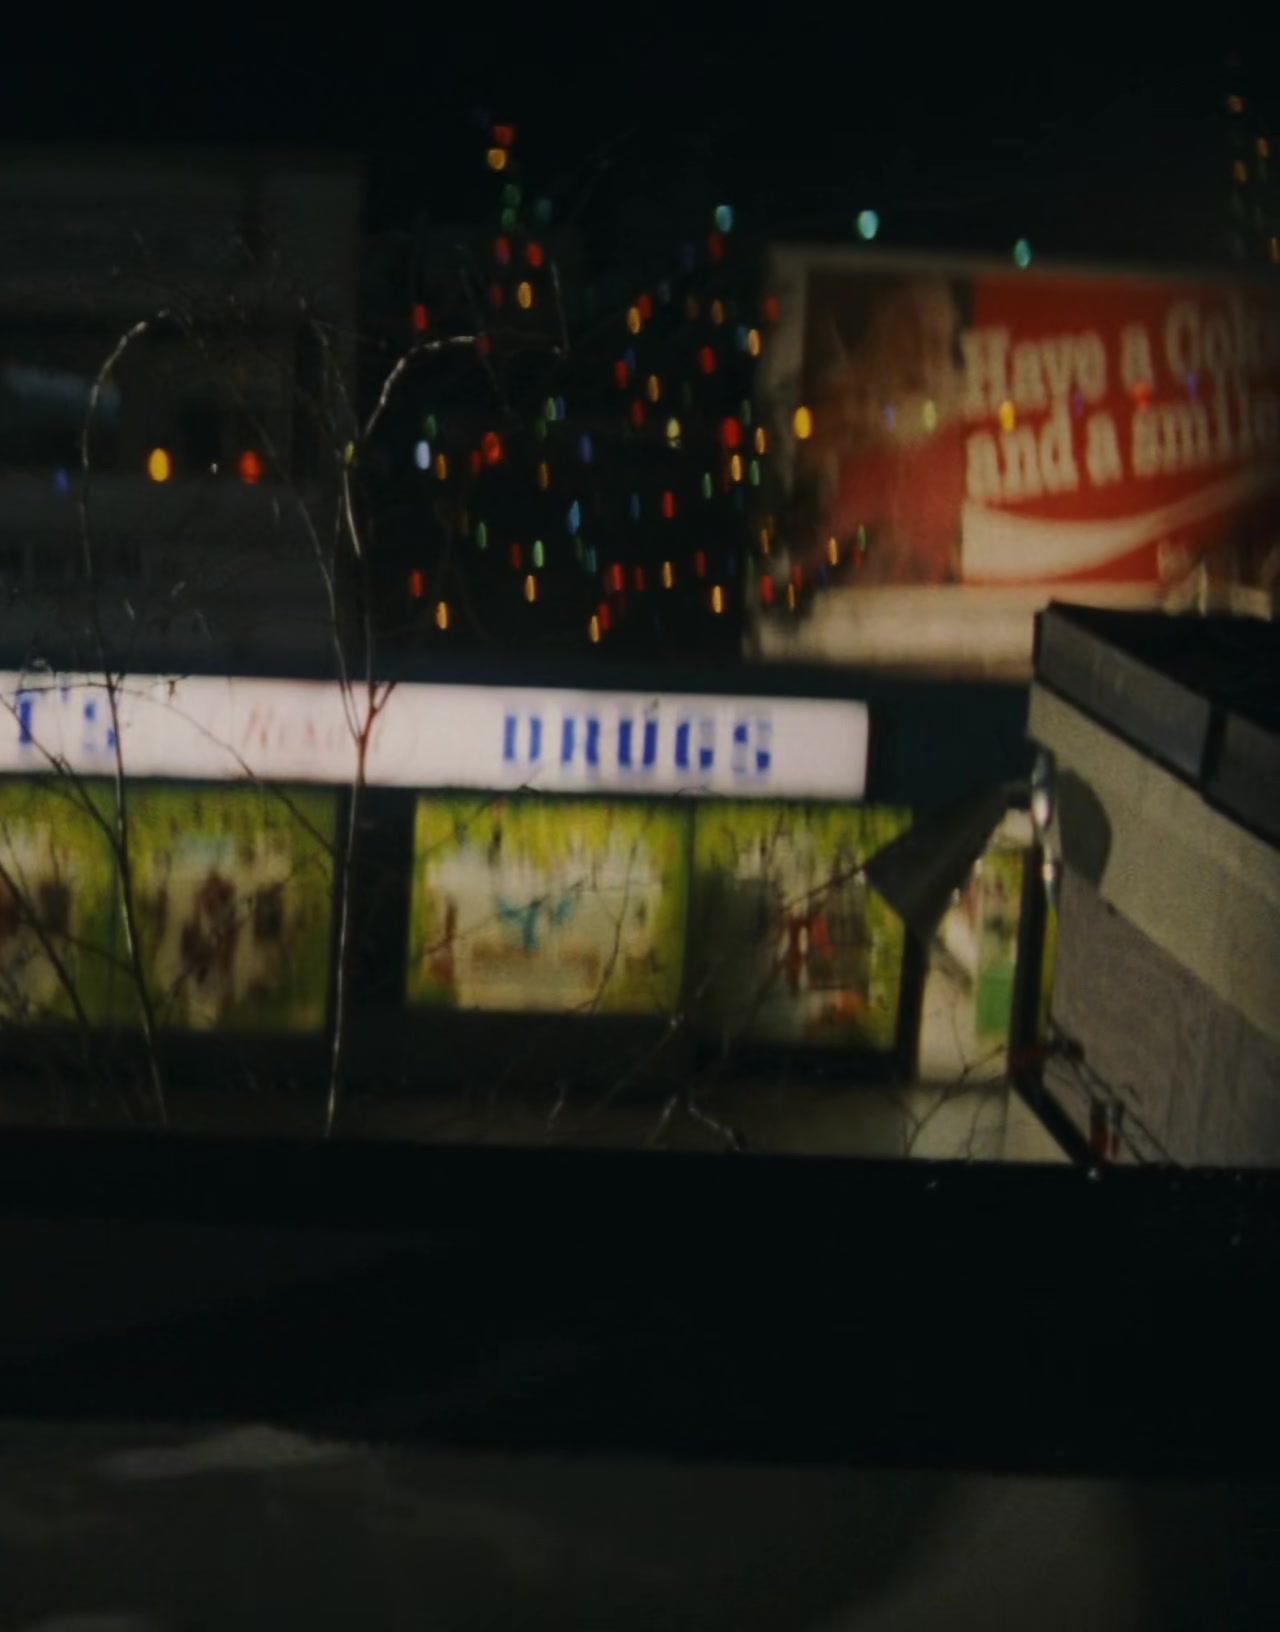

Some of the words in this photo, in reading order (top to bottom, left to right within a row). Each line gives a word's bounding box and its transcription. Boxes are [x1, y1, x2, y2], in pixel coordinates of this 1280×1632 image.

[961, 325, 1106, 422] Have
[1121, 321, 1154, 394] a
[965, 402, 1080, 504] and
[1086, 412, 1122, 487] a
[501, 704, 773, 777] DRUGS
